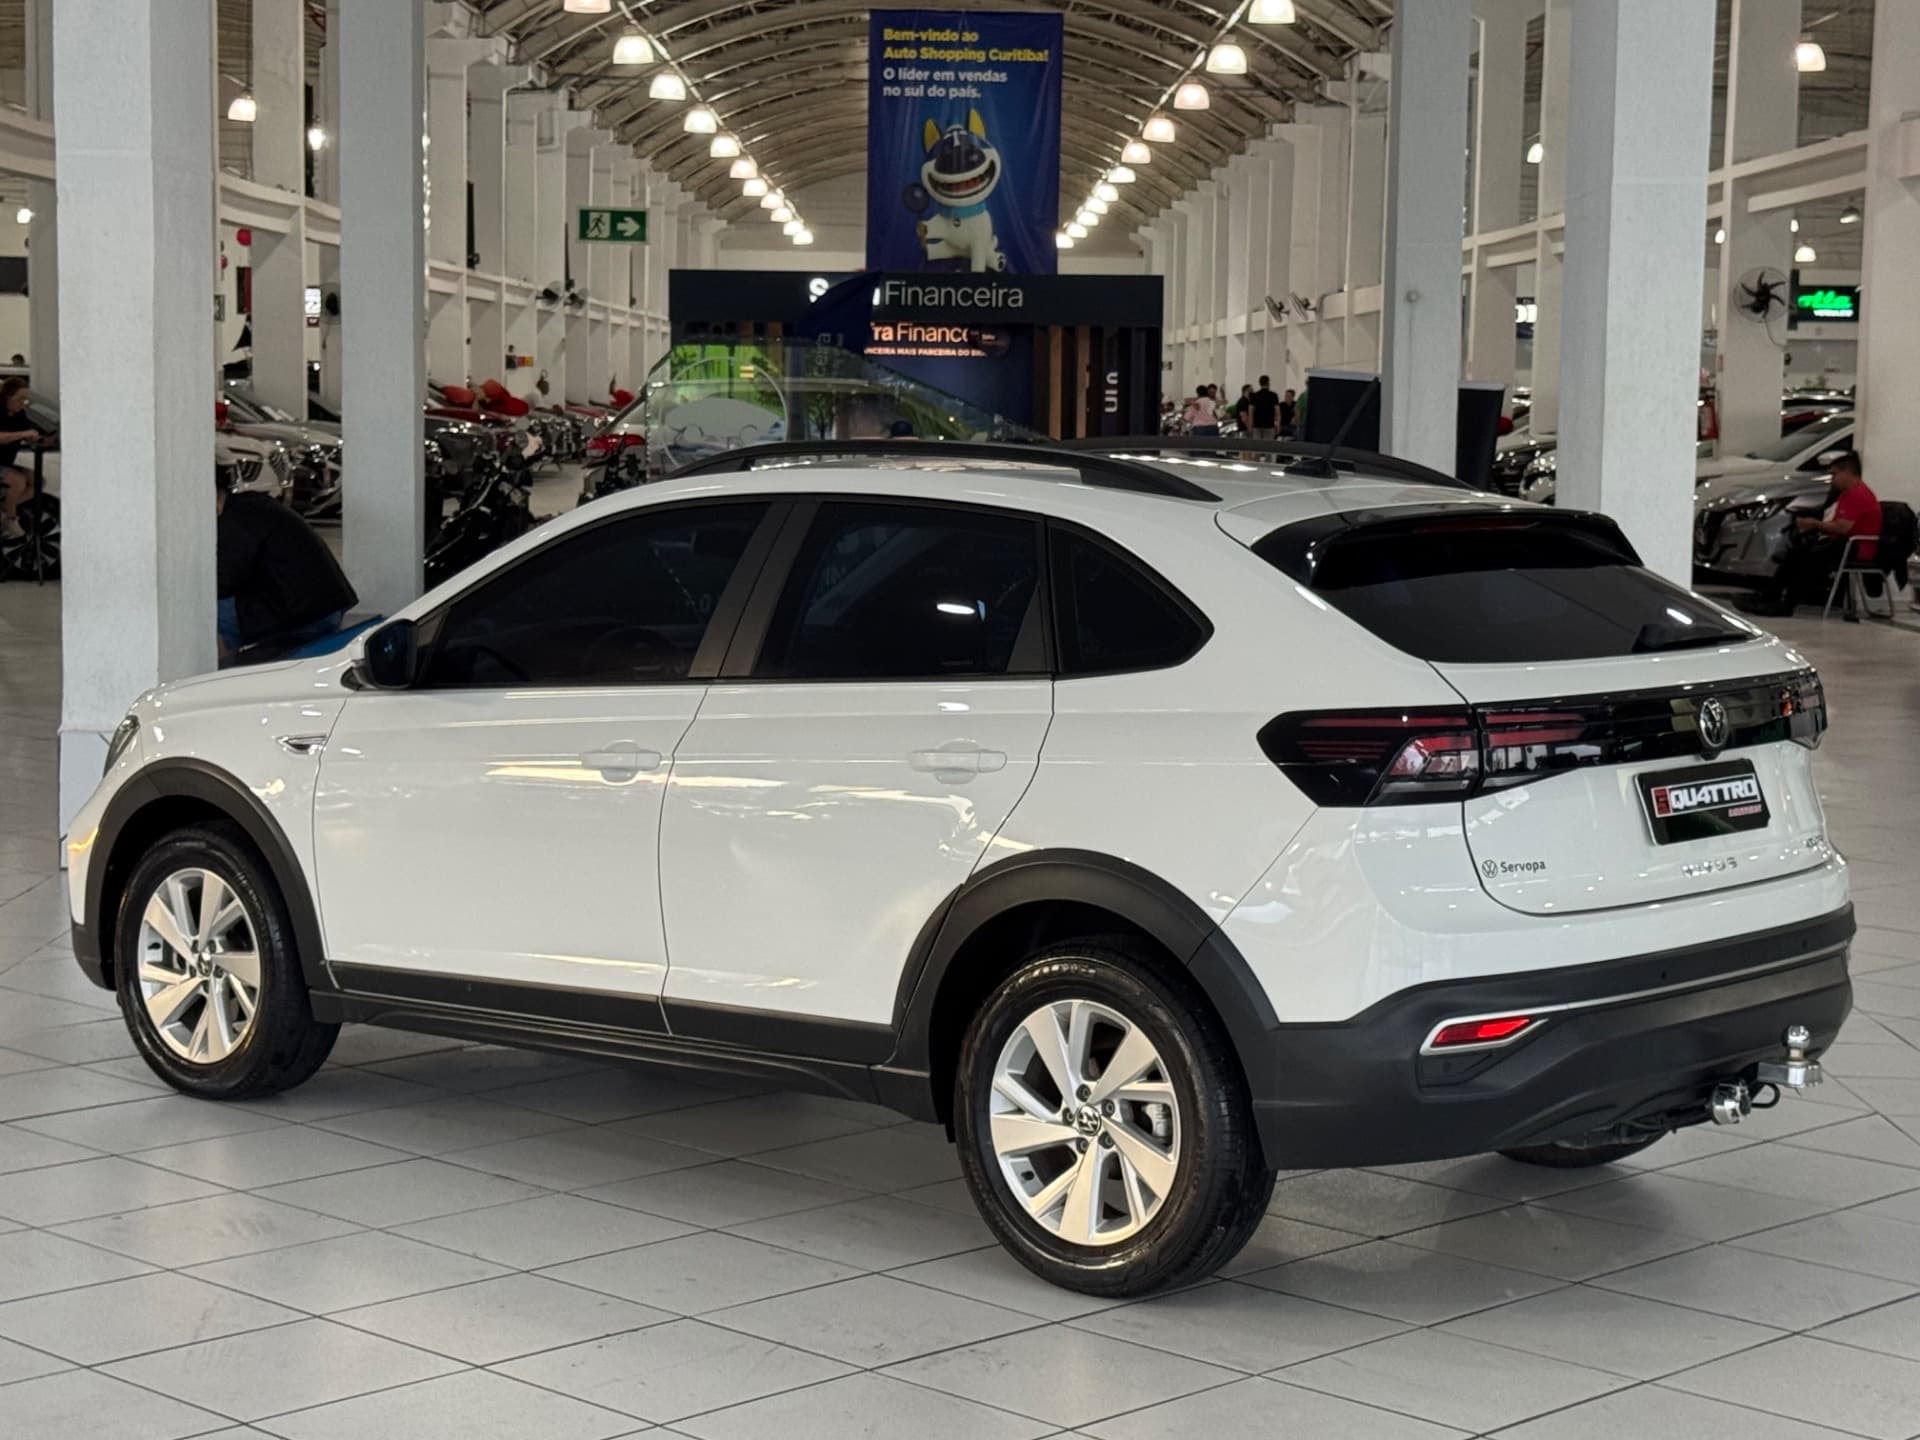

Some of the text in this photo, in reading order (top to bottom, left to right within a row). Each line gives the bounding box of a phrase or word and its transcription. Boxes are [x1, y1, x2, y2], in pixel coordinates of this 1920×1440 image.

[883, 29, 979, 42] Bem-vindo ao
[883, 48, 1049, 62] Auto Shopping Curitiba!
[883, 67, 1008, 82] O líder em vendas
[883, 85, 901, 96] no
[904, 85, 924, 97] sul
[927, 86, 946, 97] do
[884, 280, 1024, 308] Financeira
[1500, 861, 1546, 874] Servopa
